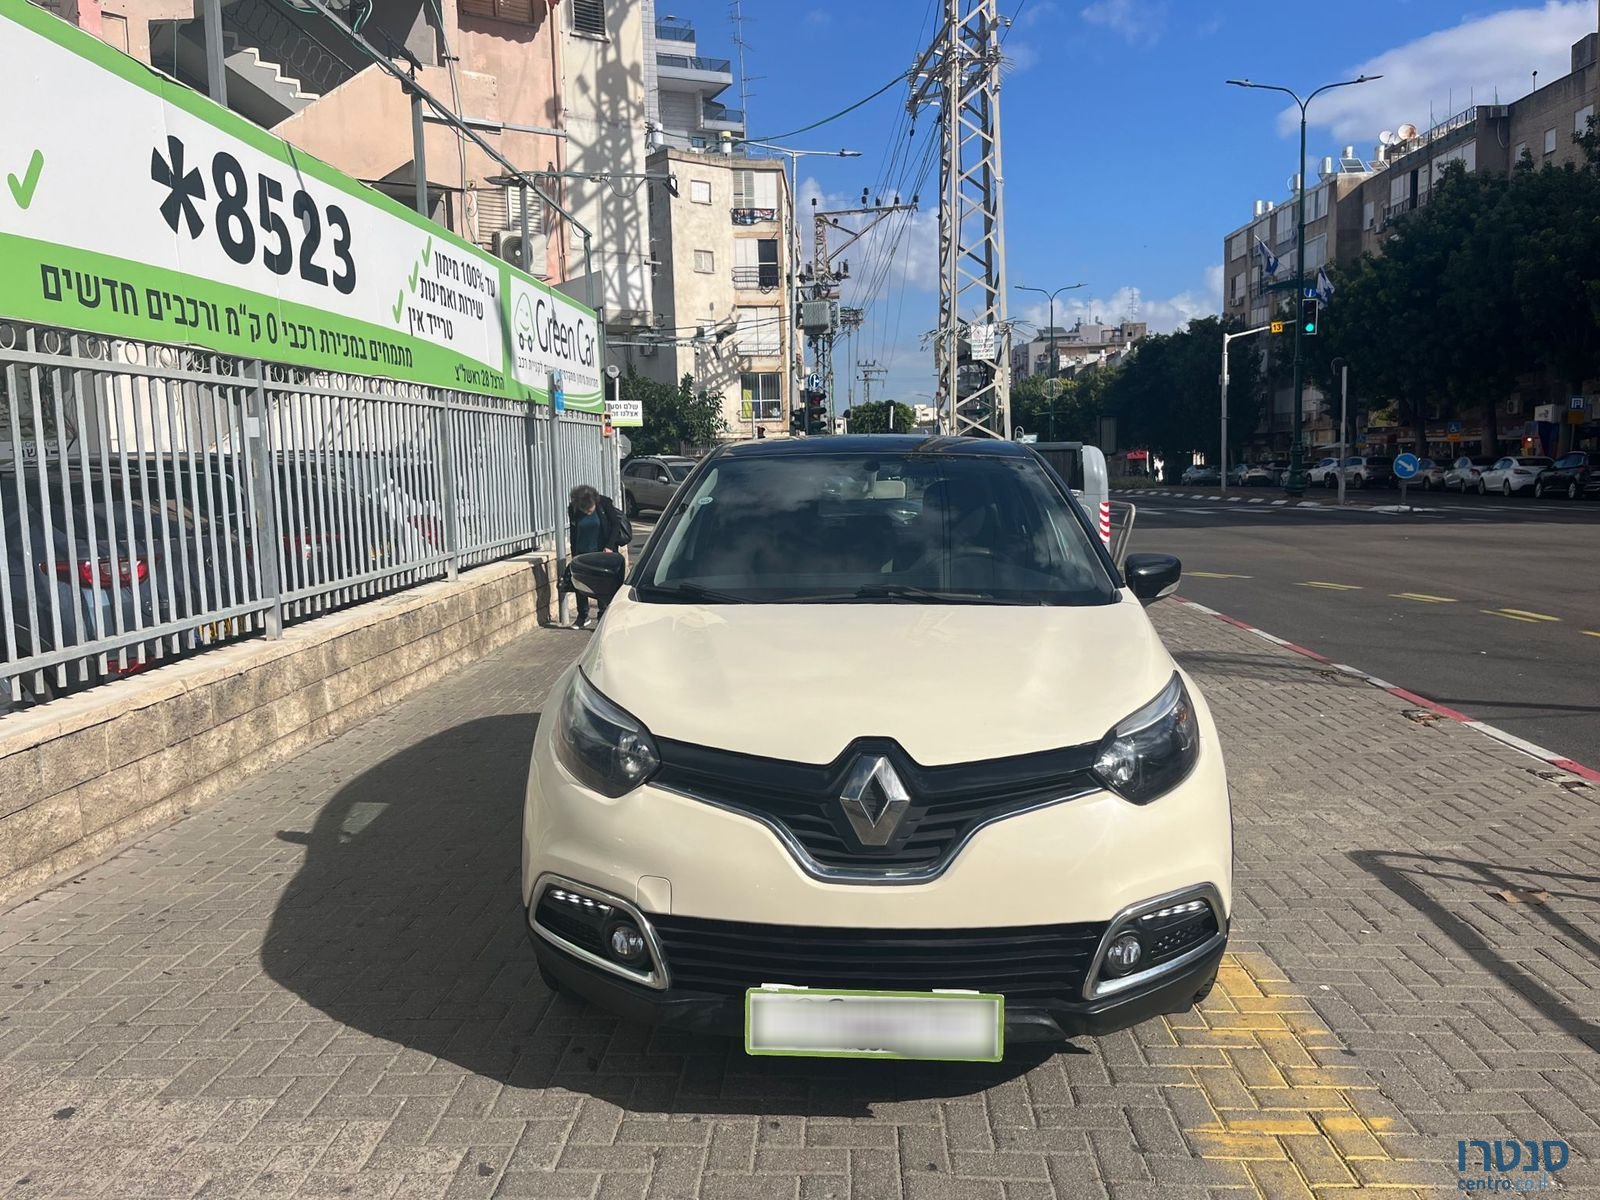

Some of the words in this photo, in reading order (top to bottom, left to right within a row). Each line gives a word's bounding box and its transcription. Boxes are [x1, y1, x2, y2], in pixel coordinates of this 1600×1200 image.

[434, 250, 459, 281] מימון
[461, 261, 485, 292] 100%
[40, 264, 139, 316] חדשים
[420, 277, 457, 311] ואמינות
[485, 276, 496, 298] עד
[146, 288, 220, 332] ורכבים
[408, 306, 425, 336] אין
[458, 293, 484, 320] שירות
[266, 312, 278, 344] 0
[281, 321, 316, 351] רכבי
[426, 312, 453, 340] טרייד
[536, 299, 576, 361] Green
[577, 318, 595, 368] Car
[320, 329, 368, 360] במכירת
[369, 339, 413, 368] מתמחים
[481, 369, 490, 387] 28
[624, 402, 639, 410] שלם
